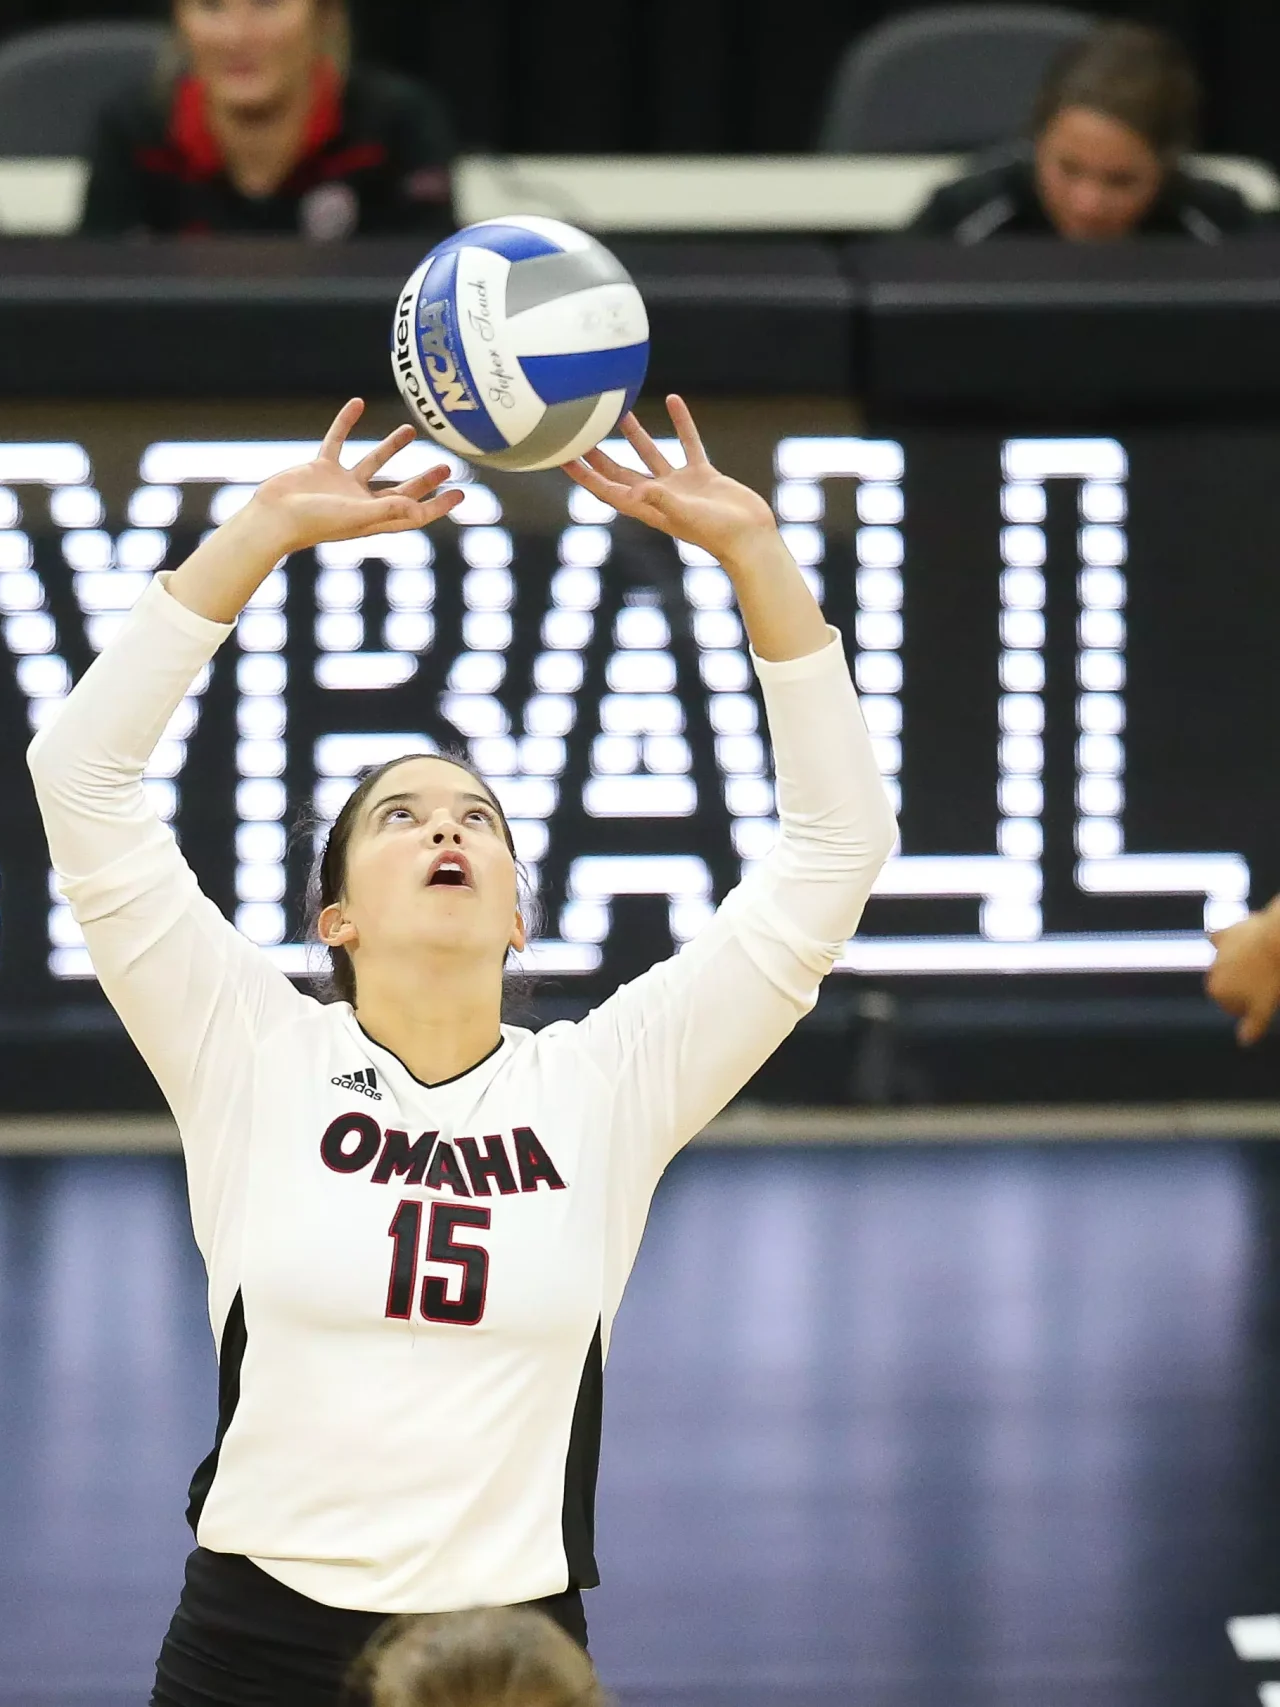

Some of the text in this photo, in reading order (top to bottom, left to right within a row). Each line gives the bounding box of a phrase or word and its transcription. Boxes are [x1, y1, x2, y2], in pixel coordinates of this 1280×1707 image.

[397, 293, 446, 431] molten
[419, 298, 479, 413] NCAA
[467, 279, 516, 409] Super Touch
[330, 1075, 383, 1101] adidas
[319, 1111, 568, 1199] OMAHA
[384, 1198, 492, 1327] 15
